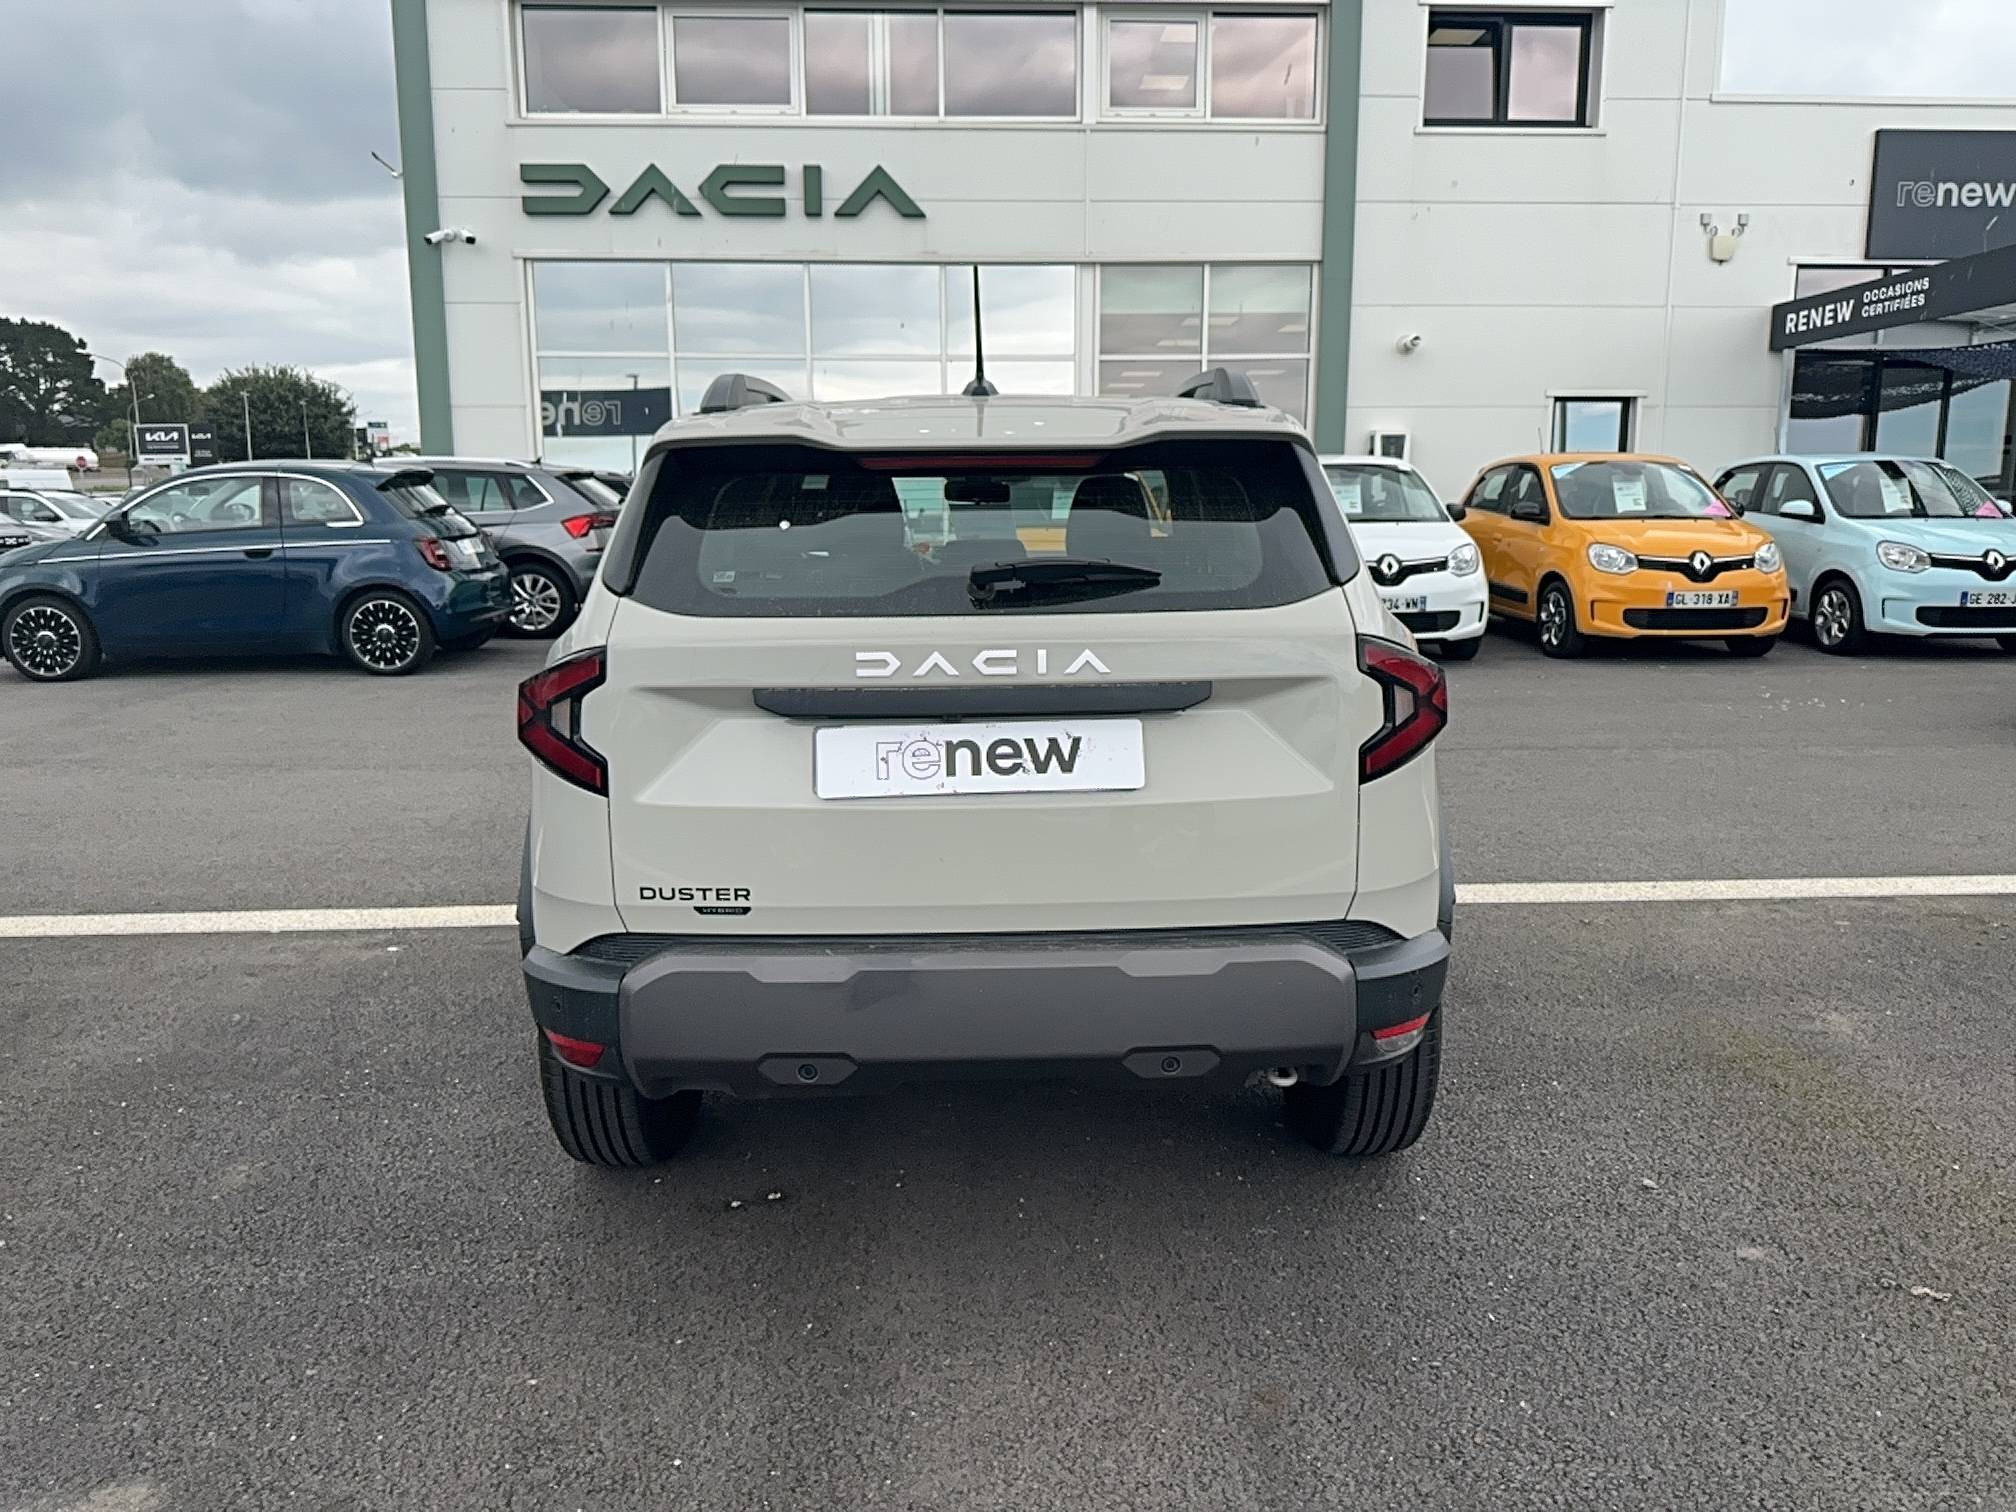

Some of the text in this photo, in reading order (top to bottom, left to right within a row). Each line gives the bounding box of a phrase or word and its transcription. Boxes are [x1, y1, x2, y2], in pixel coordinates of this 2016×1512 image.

[520, 163, 926, 217] DACIA
[1896, 181, 2016, 207] renew
[1785, 277, 1930, 334] RENEW OCCASIONS
[1861, 292, 1926, 317] CERTIFIÉES
[855, 649, 1112, 677] DACIA
[876, 736, 1082, 780] renew
[639, 887, 751, 901] DUSTER
